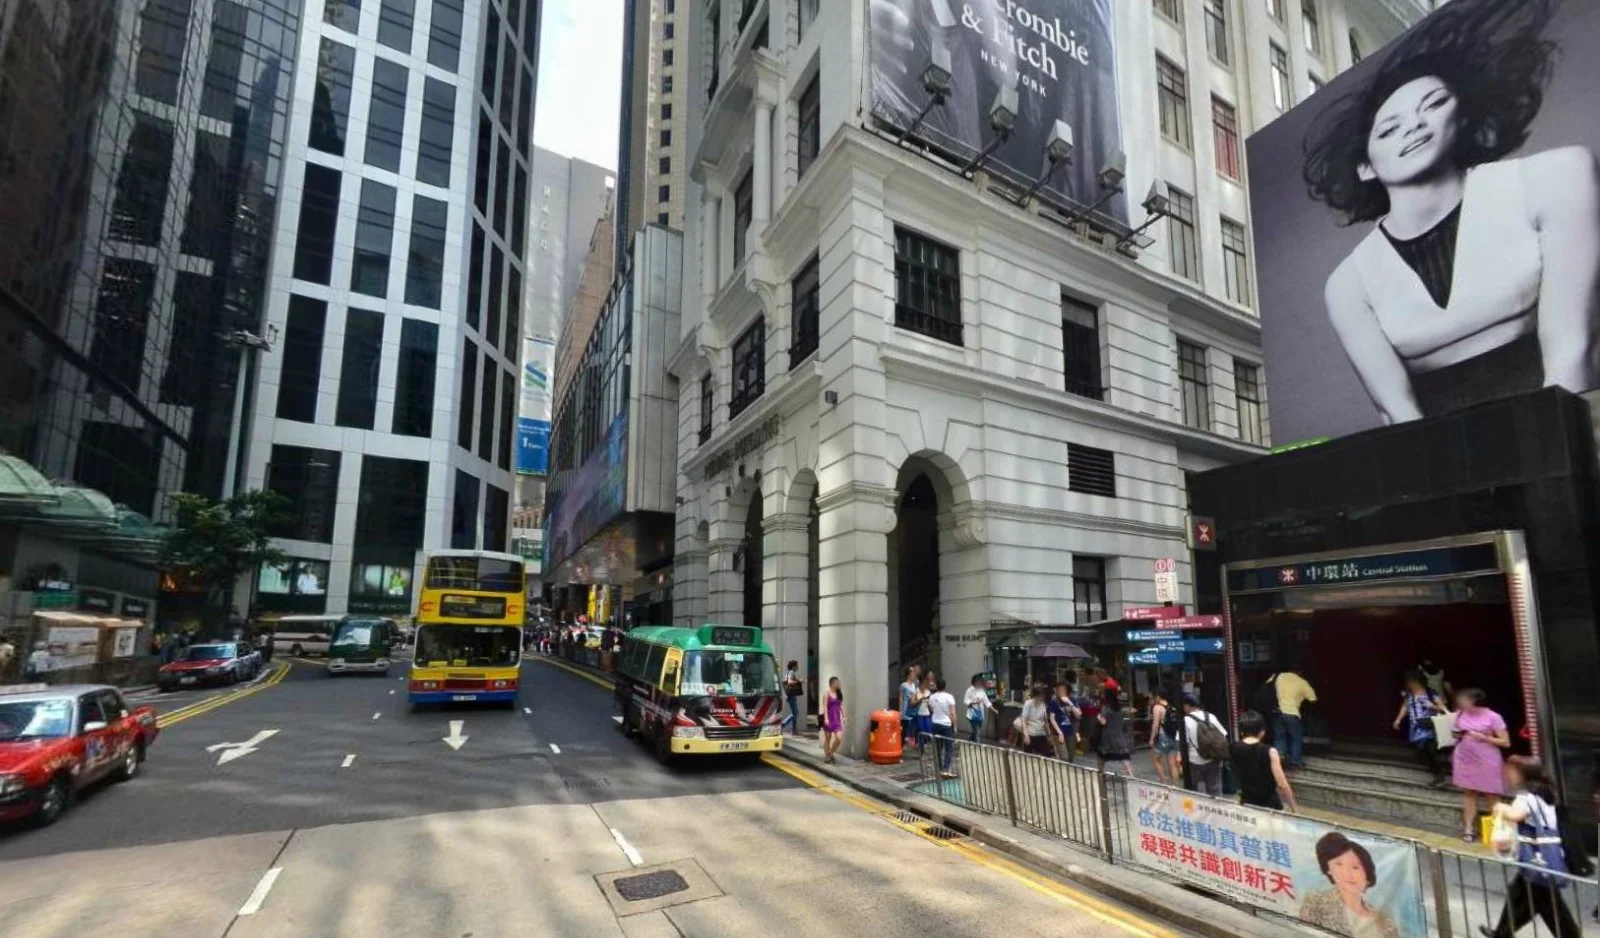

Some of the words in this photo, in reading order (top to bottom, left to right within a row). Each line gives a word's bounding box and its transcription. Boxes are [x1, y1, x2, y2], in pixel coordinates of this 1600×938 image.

[961, 4, 984, 34] &
[991, 16, 1058, 80] Fitch
[981, 49, 1008, 73] NEW
[1014, 70, 1047, 97] YORK
[1306, 563, 1359, 580] 中環站
[1362, 565, 1393, 576] Central
[1395, 564, 1428, 573] Station
[1138, 807, 1292, 868] 依法推動真普選
[1140, 832, 1296, 900] 凝聚共識創新天
